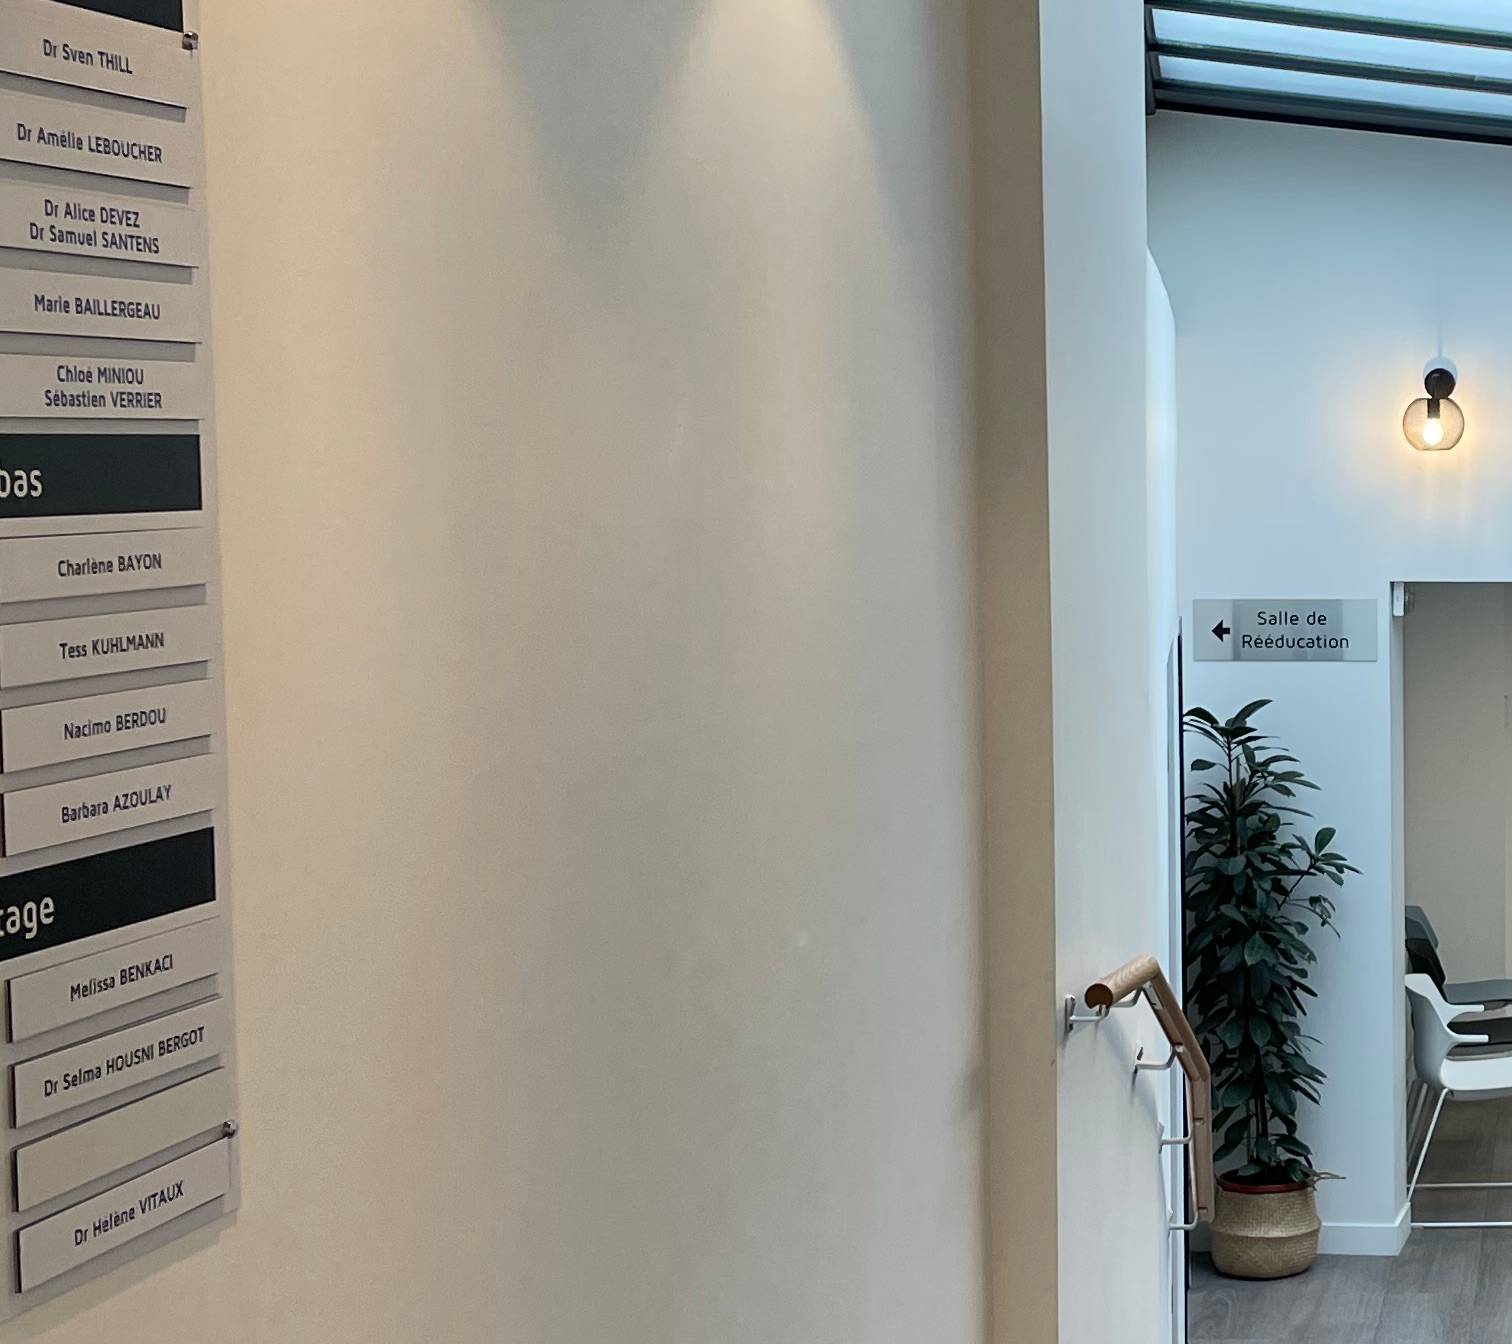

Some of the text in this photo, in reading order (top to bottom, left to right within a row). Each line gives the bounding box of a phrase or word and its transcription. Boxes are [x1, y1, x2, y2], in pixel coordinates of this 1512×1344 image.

[43, 38, 133, 75] Dr Sven THILL
[16, 122, 163, 164] Dr Amélie LEBOUCHER
[44, 199, 140, 229] Dr Alice DEVEZ
[29, 222, 160, 254] Dr Samuel SANTENS
[34, 294, 160, 320] Marie BAILLERGEAU
[57, 365, 144, 385] Chloé MINIOU
[44, 389, 162, 409] Sébastien VERRIER
[58, 552, 162, 578] Charlène BAYON
[1257, 611, 1328, 626] Salle de
[59, 632, 164, 660] Tess KUHLMANN
[1241, 633, 1350, 650] Rééducation
[116, 707, 166, 732] BERDOU
[61, 784, 172, 824] Barbara AZOULAY
[70, 954, 173, 1002] Melissa BENKACI
[44, 1026, 205, 1097] Dr Selma HOUSNI BERGOT
[74, 1179, 184, 1247] Dr Hélène VITAUX
